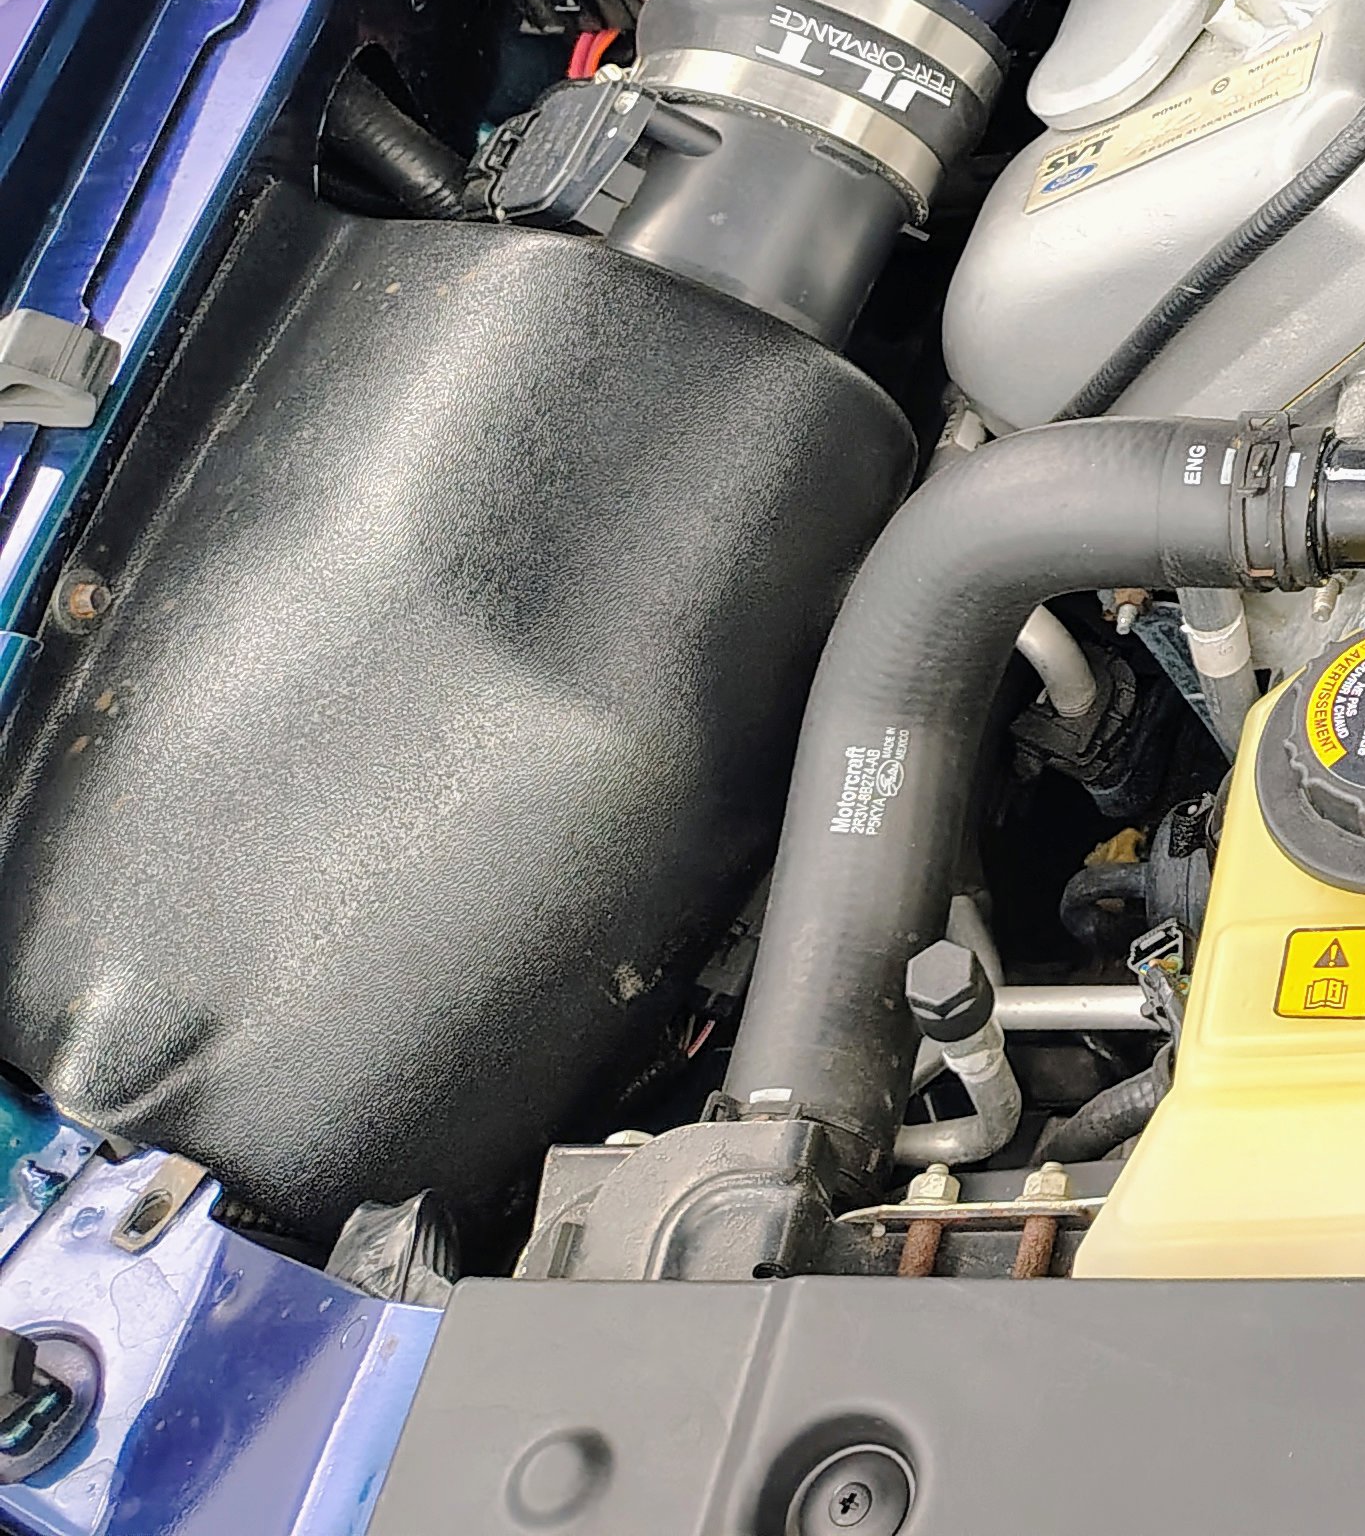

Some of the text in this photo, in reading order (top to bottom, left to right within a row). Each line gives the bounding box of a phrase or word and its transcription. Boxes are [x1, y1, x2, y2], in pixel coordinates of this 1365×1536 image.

[769, 4, 957, 98] PERFORMANCE
[755, 31, 951, 112] JLT
[1183, 445, 1207, 485] ENG
[1314, 650, 1361, 754] AVERTISSEMENT
[1333, 704, 1350, 739] CHAUD
[1346, 696, 1361, 717] PAS
[882, 726, 897, 759] MADE IN
[895, 729, 910, 760] MEXICO
[830, 745, 867, 833] Motorcraft
